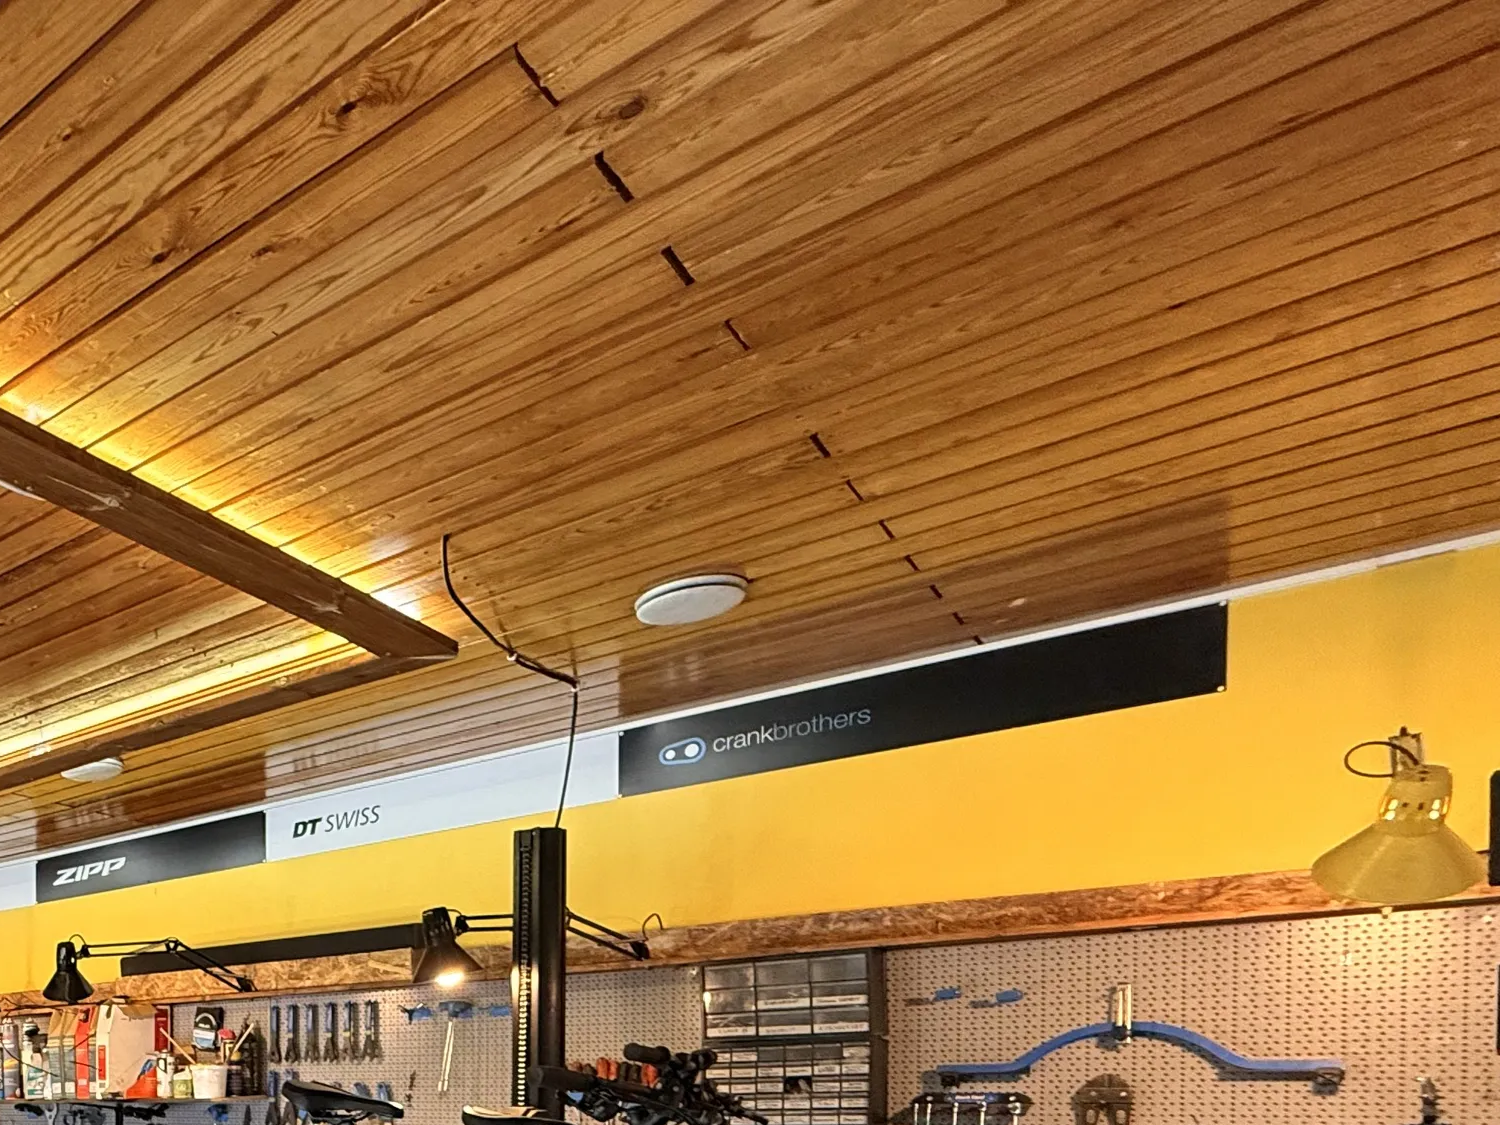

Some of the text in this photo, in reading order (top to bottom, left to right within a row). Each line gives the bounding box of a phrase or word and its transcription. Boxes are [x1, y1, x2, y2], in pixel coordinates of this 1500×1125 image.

[712, 708, 872, 753] crankbrothers
[291, 804, 382, 839] DT SWISS
[52, 856, 127, 887] ZIPP
